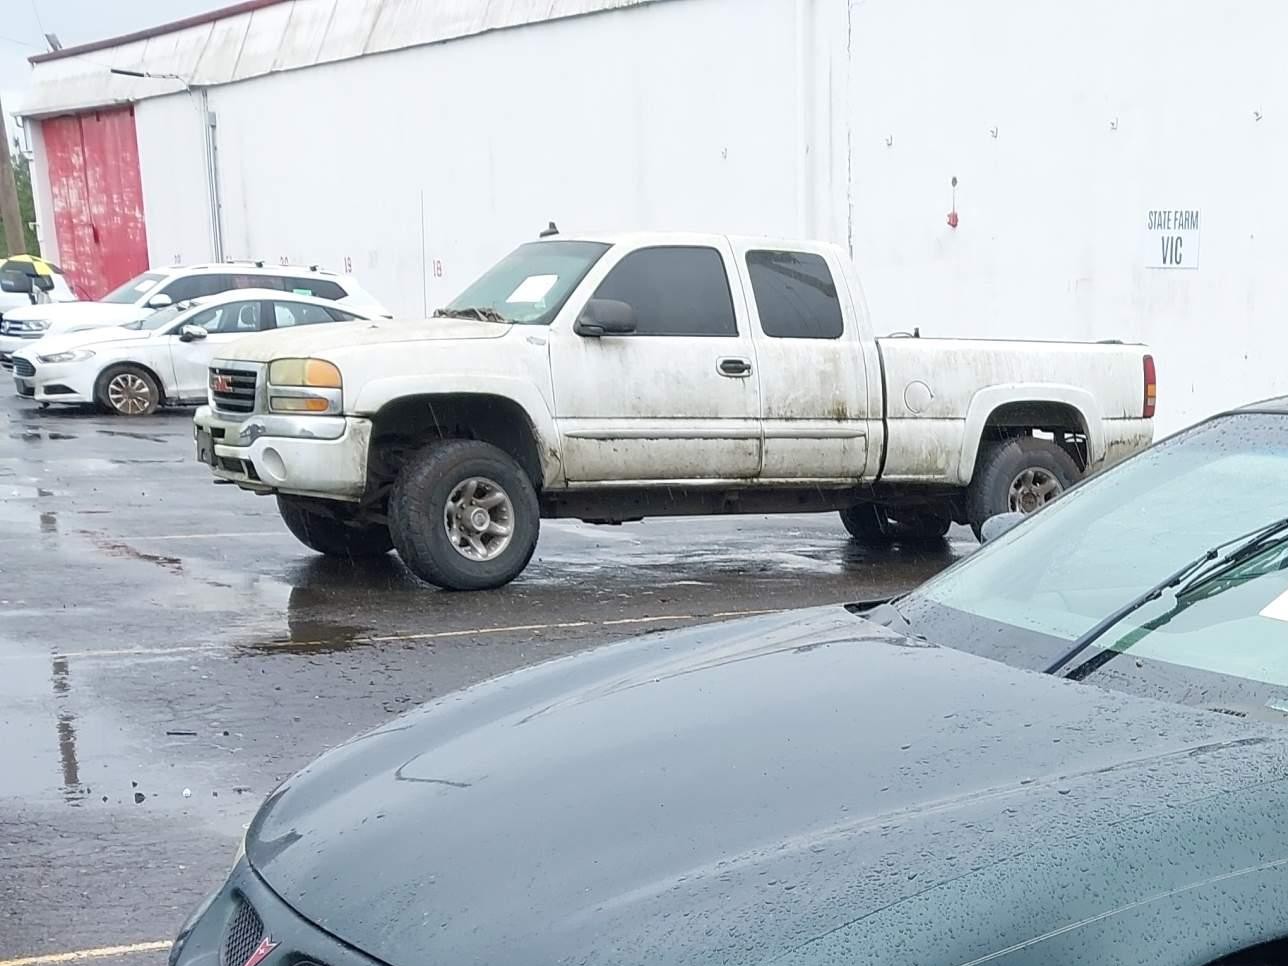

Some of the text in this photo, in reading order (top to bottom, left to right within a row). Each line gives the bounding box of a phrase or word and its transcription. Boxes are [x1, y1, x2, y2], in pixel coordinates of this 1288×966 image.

[1147, 210, 1199, 230] STATE FARM
[1161, 236, 1183, 265] VIC
